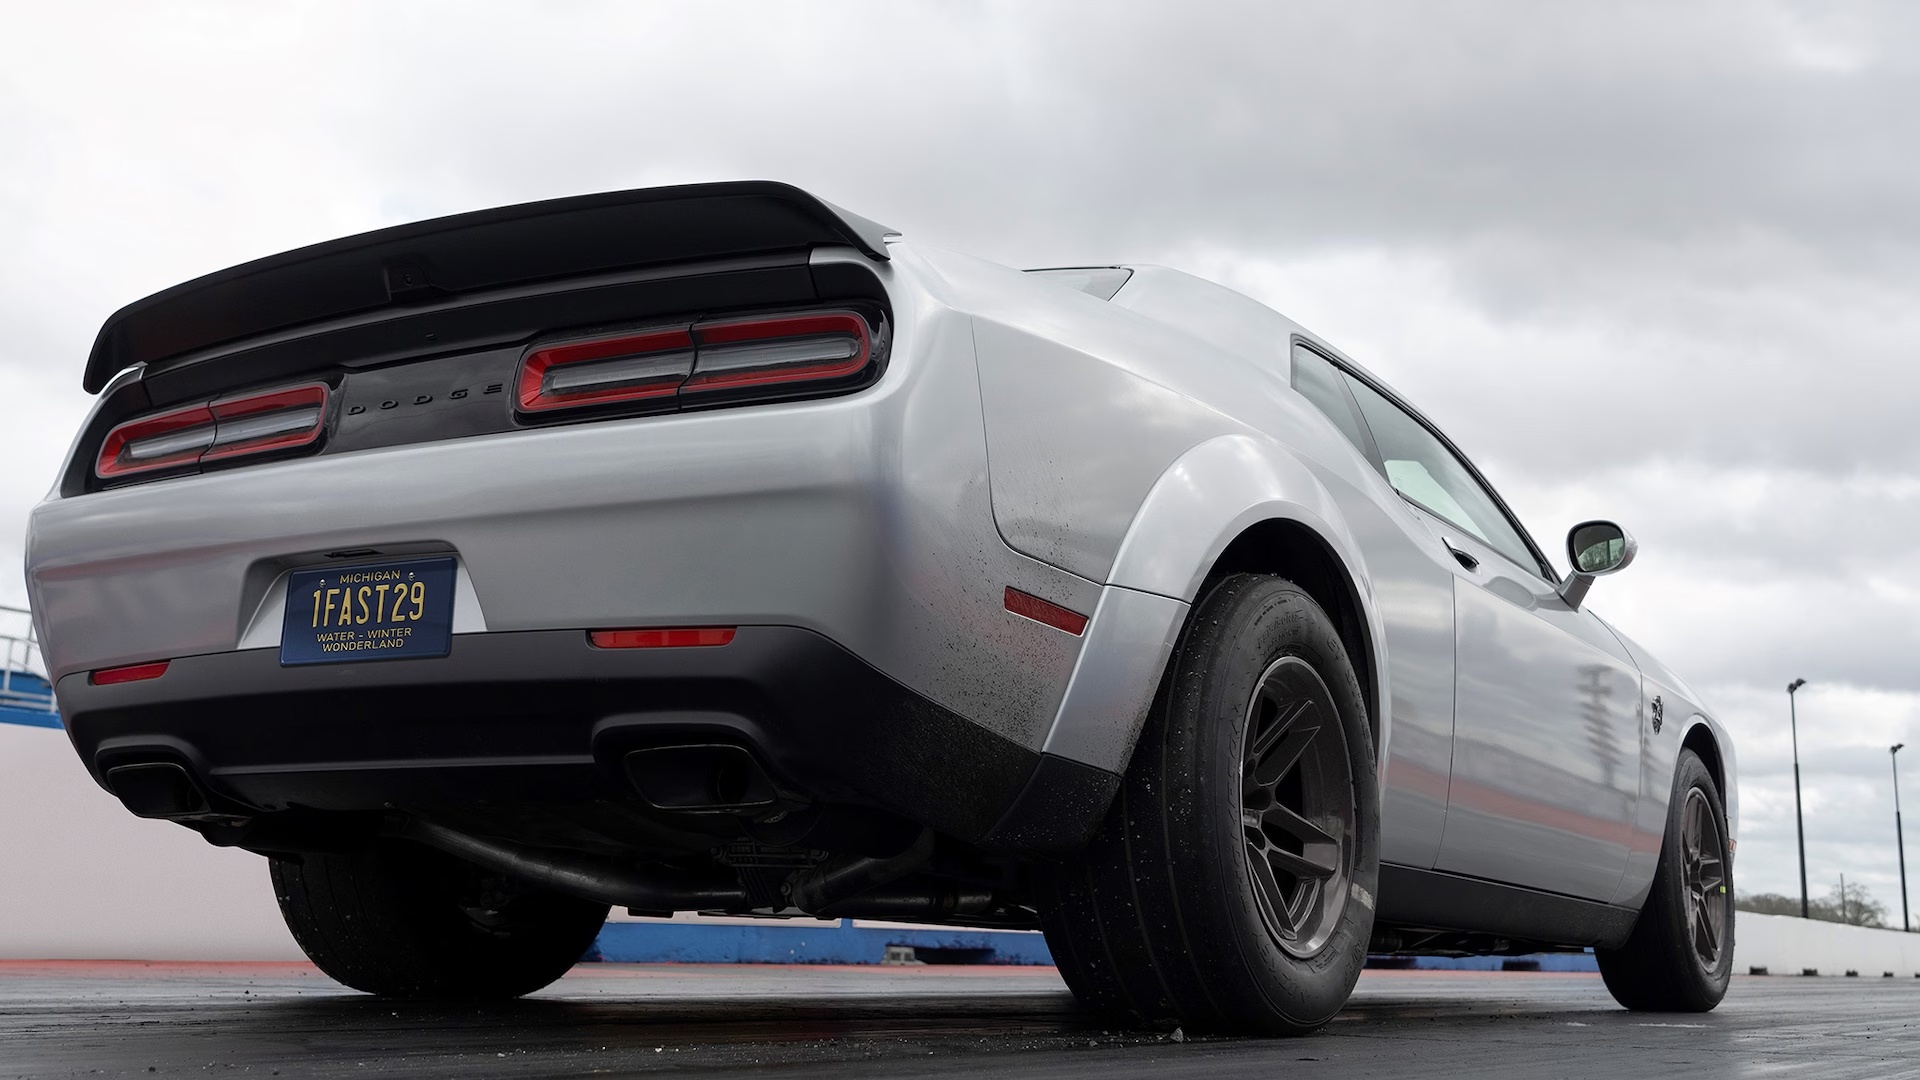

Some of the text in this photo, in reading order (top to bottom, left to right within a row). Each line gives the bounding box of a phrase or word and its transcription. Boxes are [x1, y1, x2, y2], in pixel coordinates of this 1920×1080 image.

[348, 383, 503, 416] DODGE
[339, 569, 401, 585] MICHIGAN
[312, 581, 426, 628] 1FAST29
[317, 631, 355, 643] WATER
[367, 627, 412, 641] WINTER
[322, 638, 404, 653] WONDERLAND
